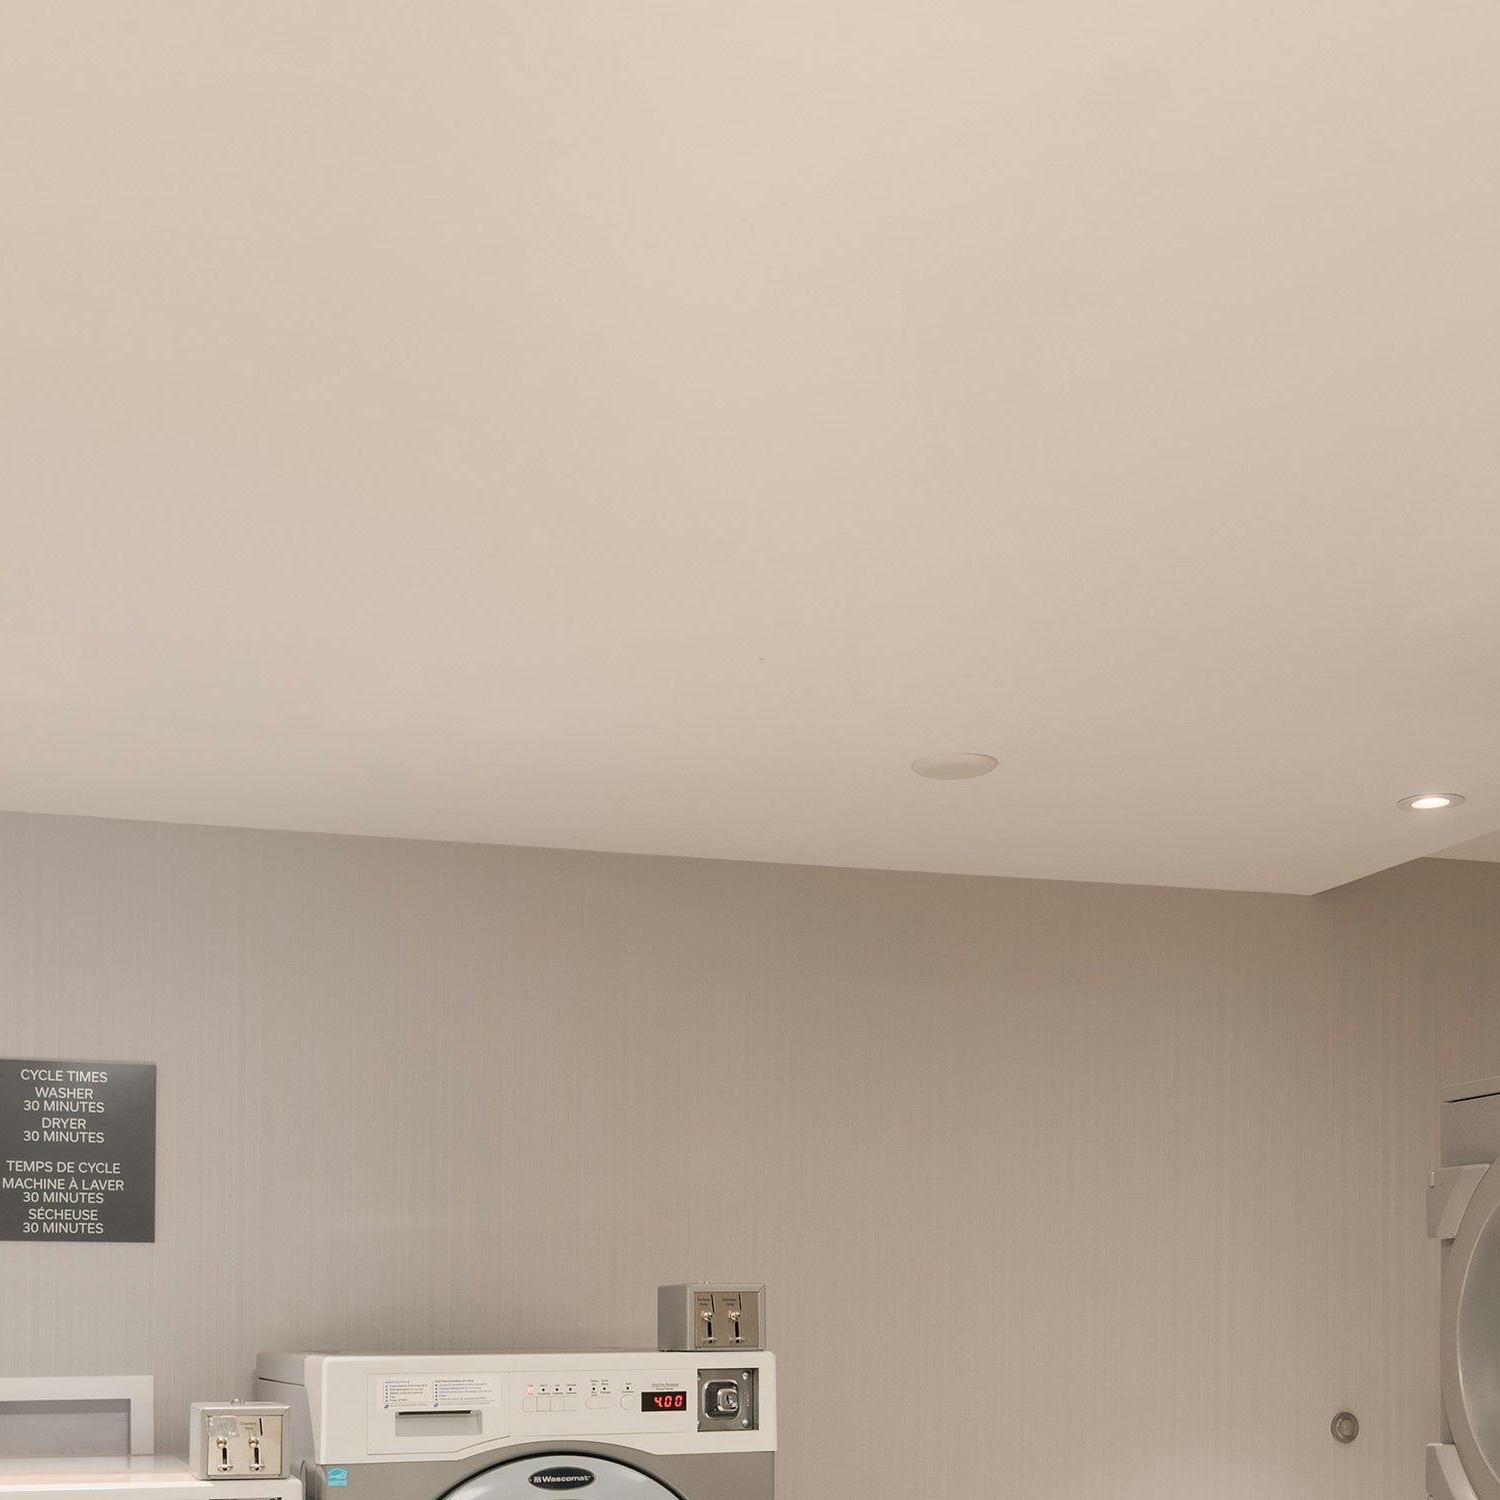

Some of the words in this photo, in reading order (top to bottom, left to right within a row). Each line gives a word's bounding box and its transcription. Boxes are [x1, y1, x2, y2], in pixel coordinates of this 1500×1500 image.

[20, 1069, 64, 1082] CYCLE
[66, 1070, 108, 1083] TIMES
[35, 1087, 94, 1100] WASHER
[23, 1100, 40, 1111] 30
[43, 1101, 105, 1113] MINUTES
[42, 1117, 87, 1130] DRYER
[23, 1130, 40, 1142] 30
[43, 1131, 105, 1144] MINUTES
[6, 1160, 53, 1173] TEMPS
[56, 1162, 75, 1173] DE
[78, 1163, 121, 1175] CYCLE
[2, 1177, 65, 1190] MACHINE
[68, 1176, 78, 1190] À
[82, 1179, 124, 1191] LAVER
[23, 1192, 39, 1203] 30
[43, 1192, 104, 1204] MINUTES
[28, 1206, 99, 1221] SÉCHEUSE
[23, 1222, 39, 1233] 30
[43, 1222, 104, 1234] MINUTES
[542, 1475, 589, 1483] Wascomat
